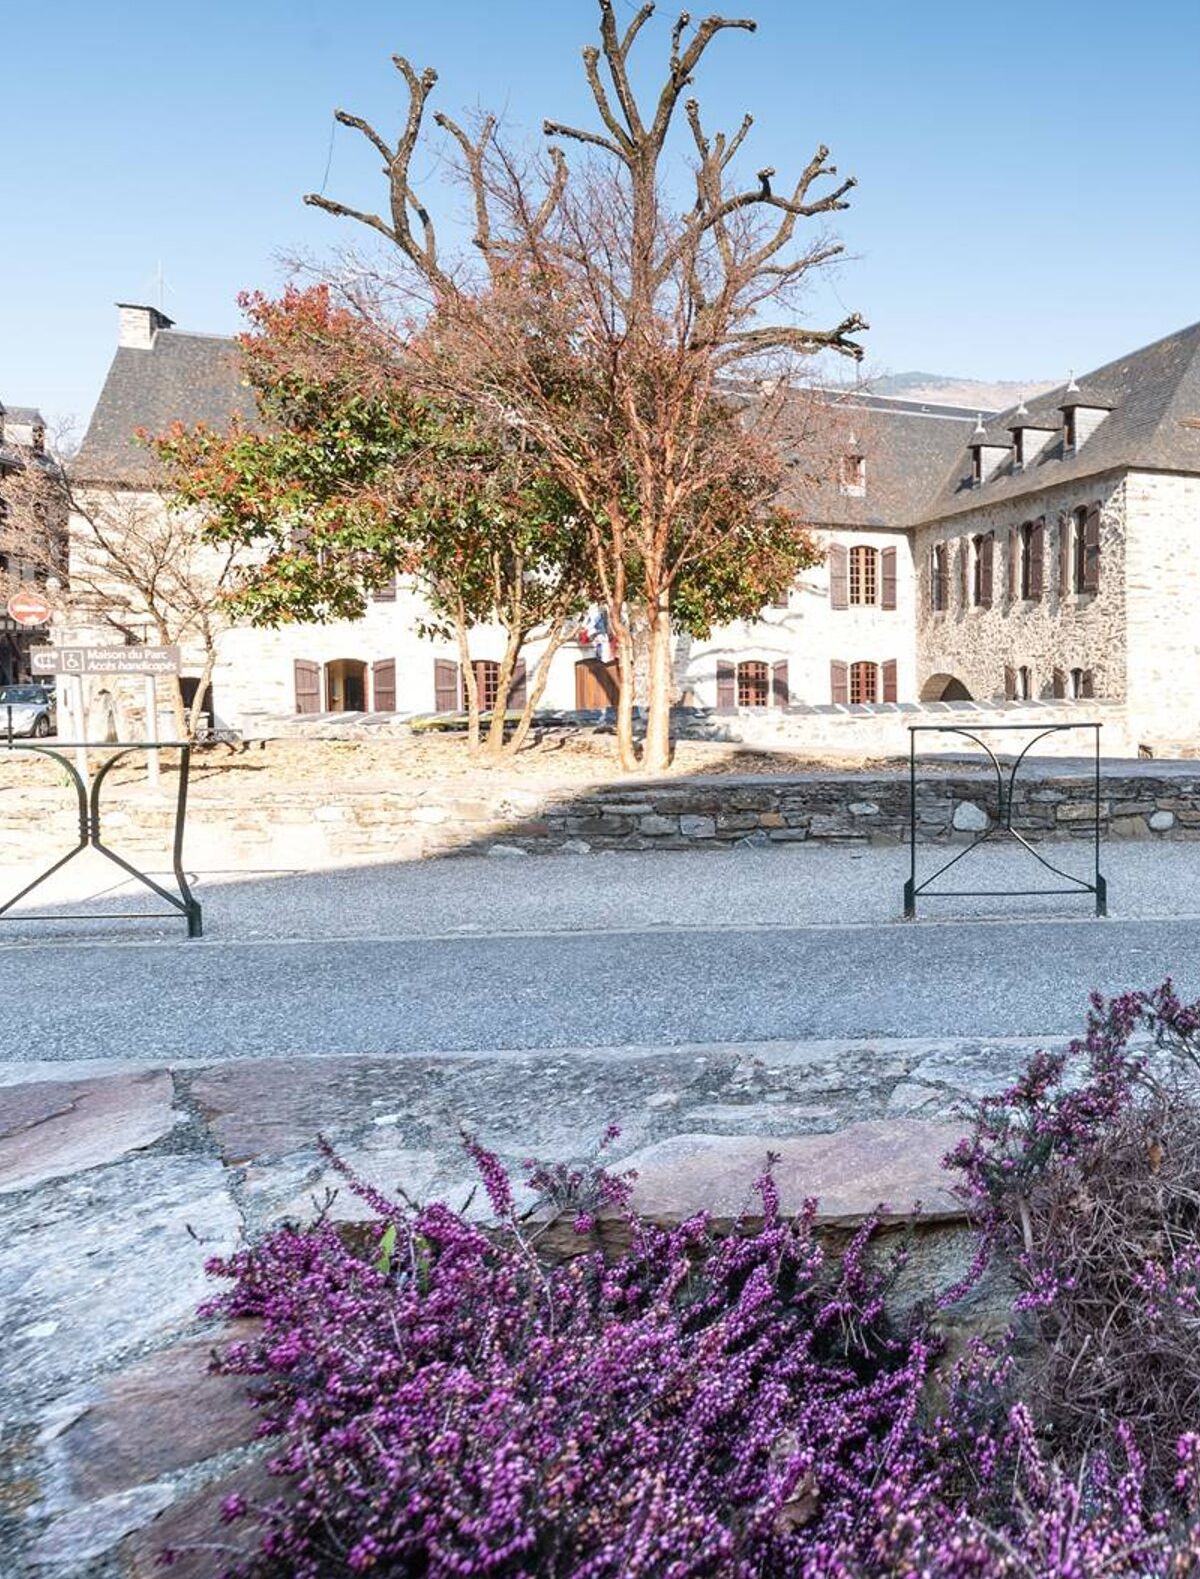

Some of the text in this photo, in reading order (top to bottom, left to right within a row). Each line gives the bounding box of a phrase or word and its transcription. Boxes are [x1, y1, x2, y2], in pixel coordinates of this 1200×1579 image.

[87, 649, 167, 660] Maison du Parc
[88, 660, 177, 672] Accès handicapés
